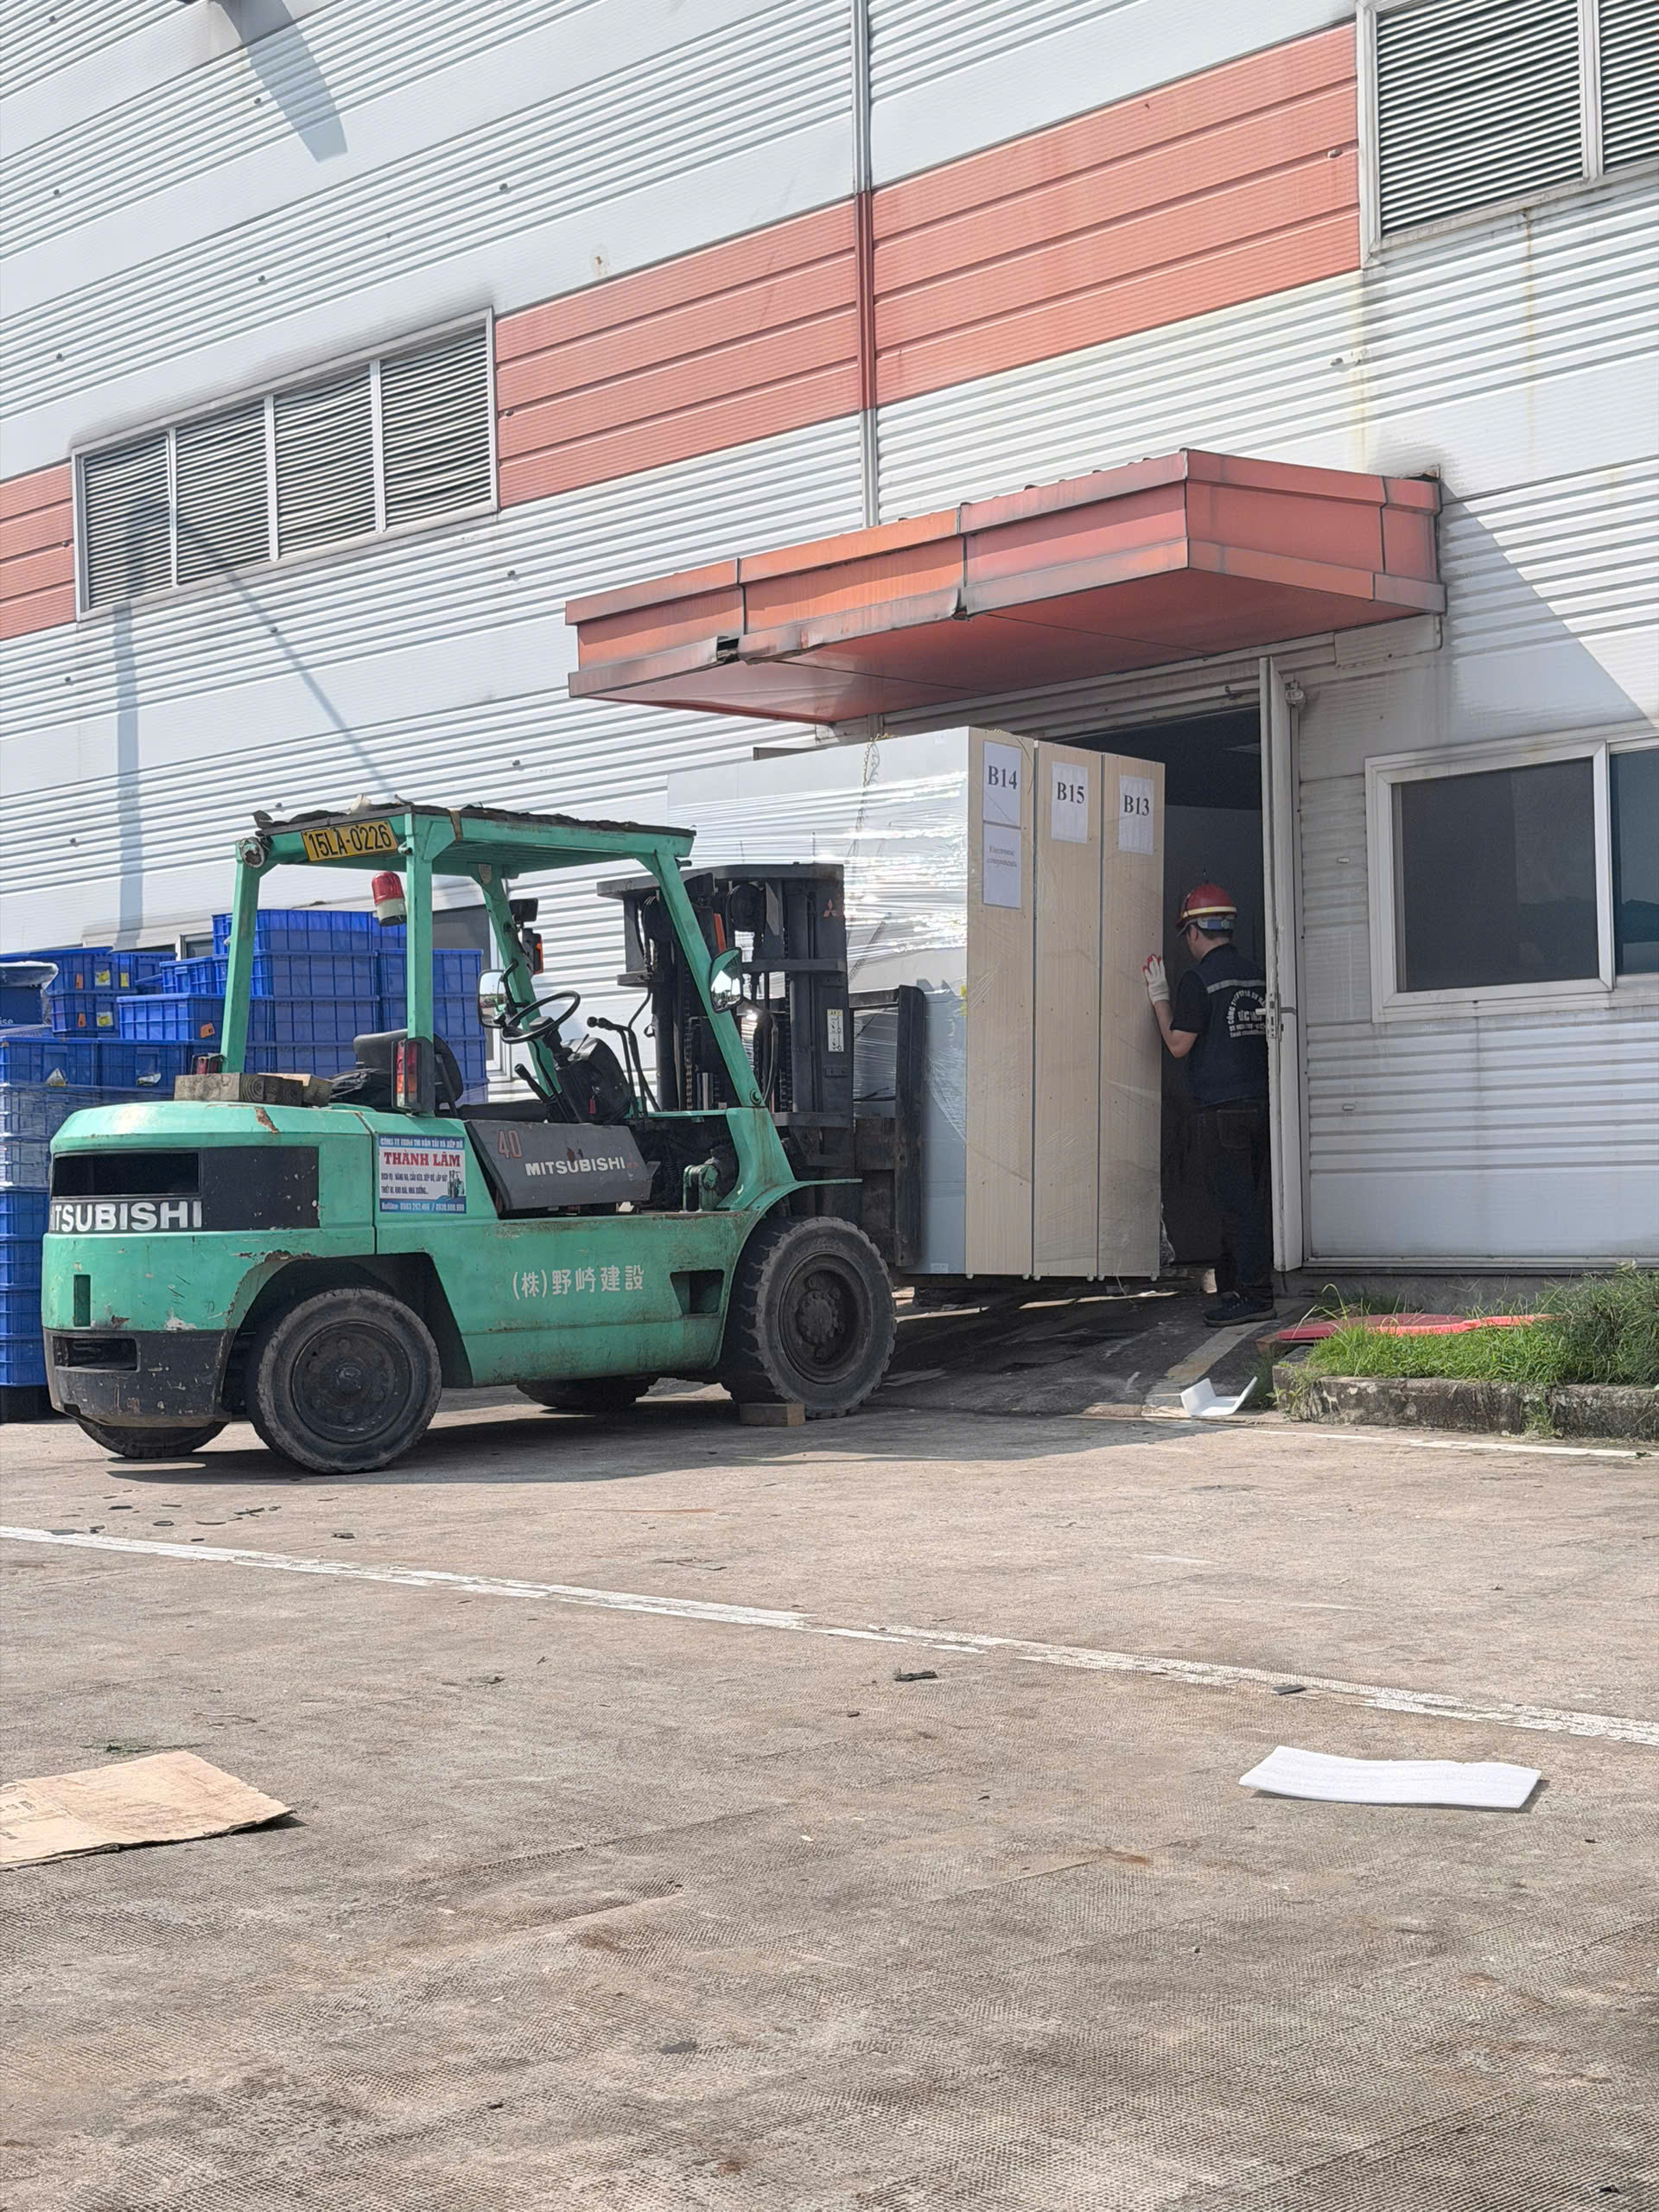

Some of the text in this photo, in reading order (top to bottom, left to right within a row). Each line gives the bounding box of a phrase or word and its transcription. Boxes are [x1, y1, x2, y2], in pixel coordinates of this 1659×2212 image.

[988, 766, 1018, 790] B14
[1057, 782, 1085, 804] B15
[1123, 795, 1150, 817] B13
[308, 824, 391, 858] 15LA-0226
[498, 1129, 523, 1159] 40
[384, 1149, 461, 1167] THÀNH LÂM
[524, 1156, 626, 1176] MITSUBISHI
